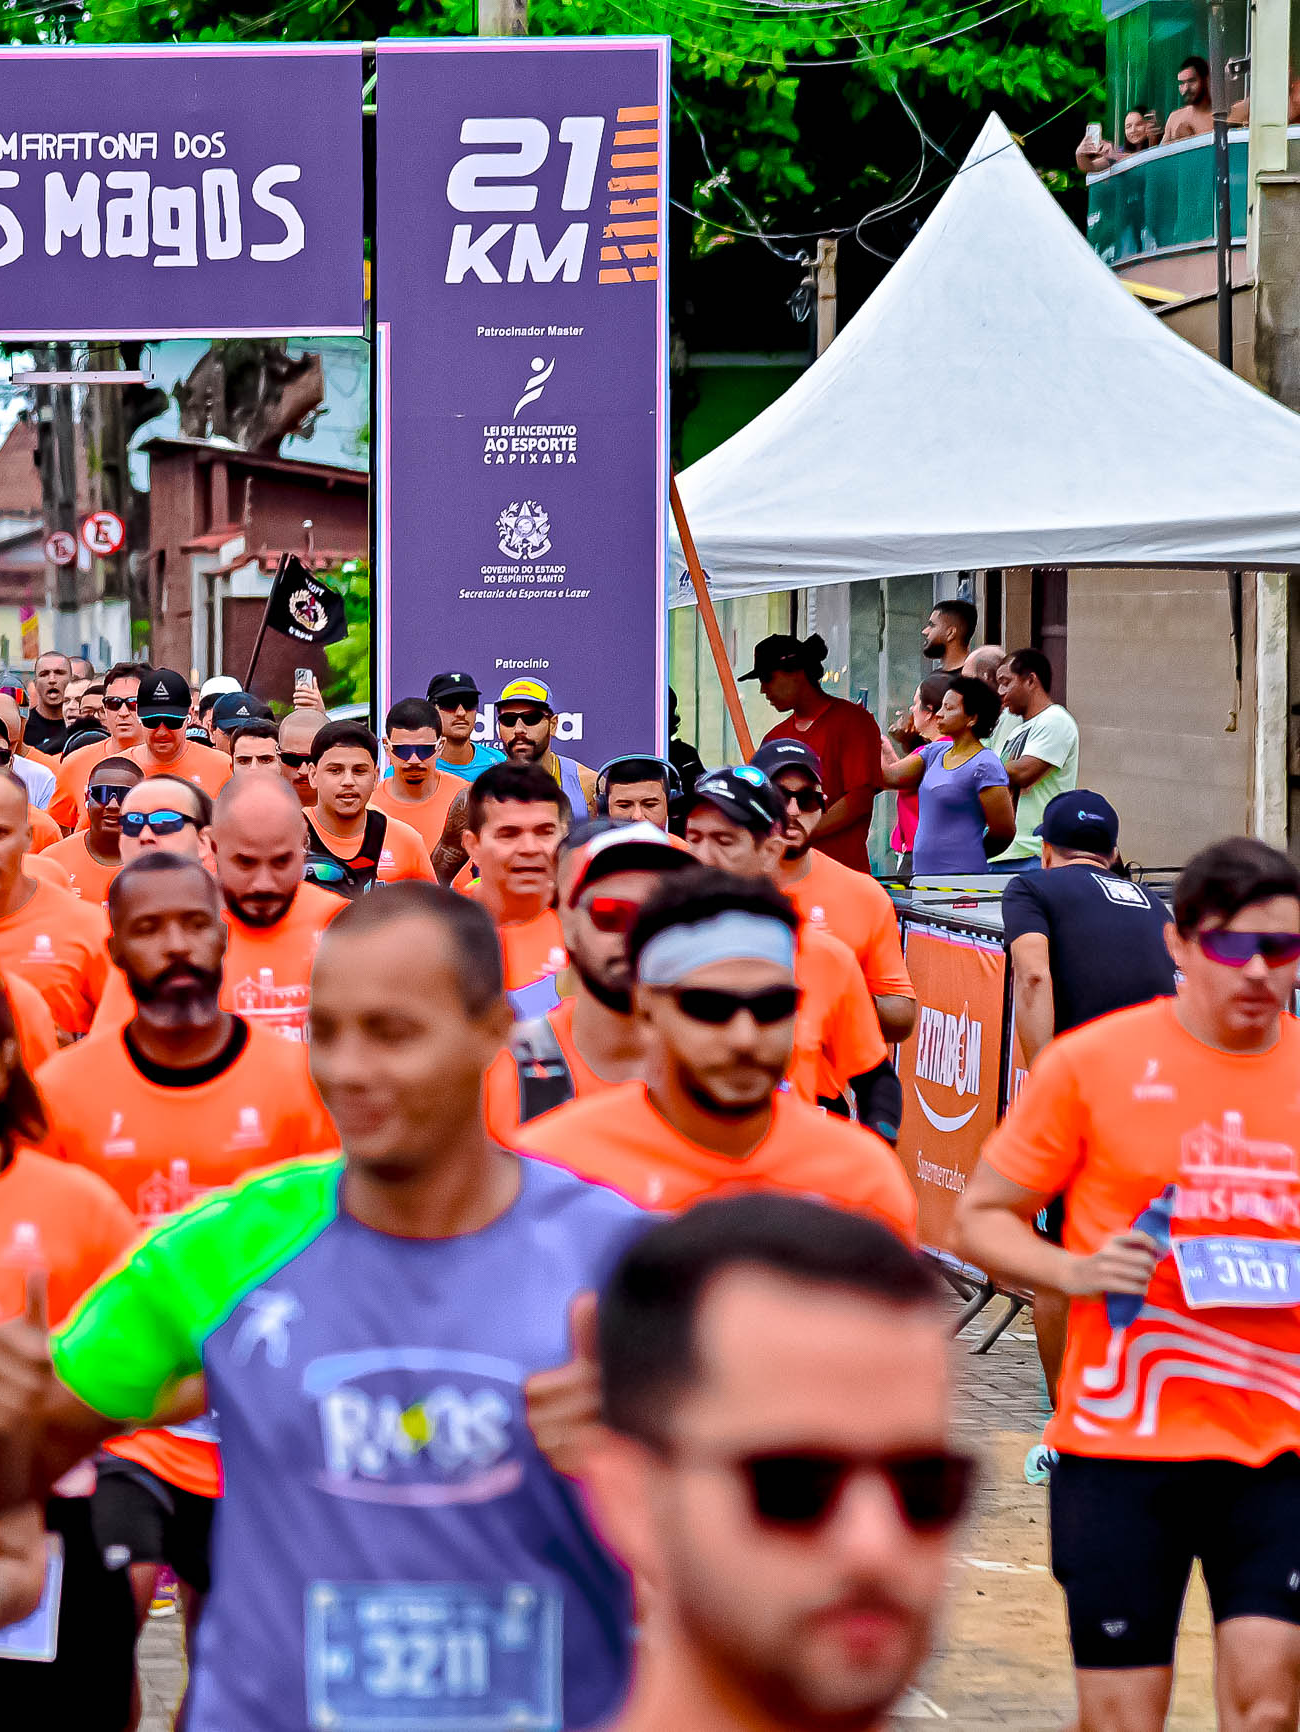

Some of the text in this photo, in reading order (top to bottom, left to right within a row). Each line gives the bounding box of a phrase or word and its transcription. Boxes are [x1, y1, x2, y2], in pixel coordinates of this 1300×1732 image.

[174, 131, 226, 159] DOS
[446, 116, 606, 213] 21
[444, 222, 589, 285] KM
[477, 325, 584, 337] Patrocinador Master
[483, 425, 577, 437] LEI DE INCENTIVO
[483, 437, 577, 453] AO ESPORTE
[483, 452, 577, 465] CAPIXABA
[480, 565, 566, 575] GOVERNO DO ESTADO
[483, 574, 496, 584] DO
[537, 574, 564, 583] SANTO
[458, 587, 591, 600] Secretaria de Esportes e Lazer
